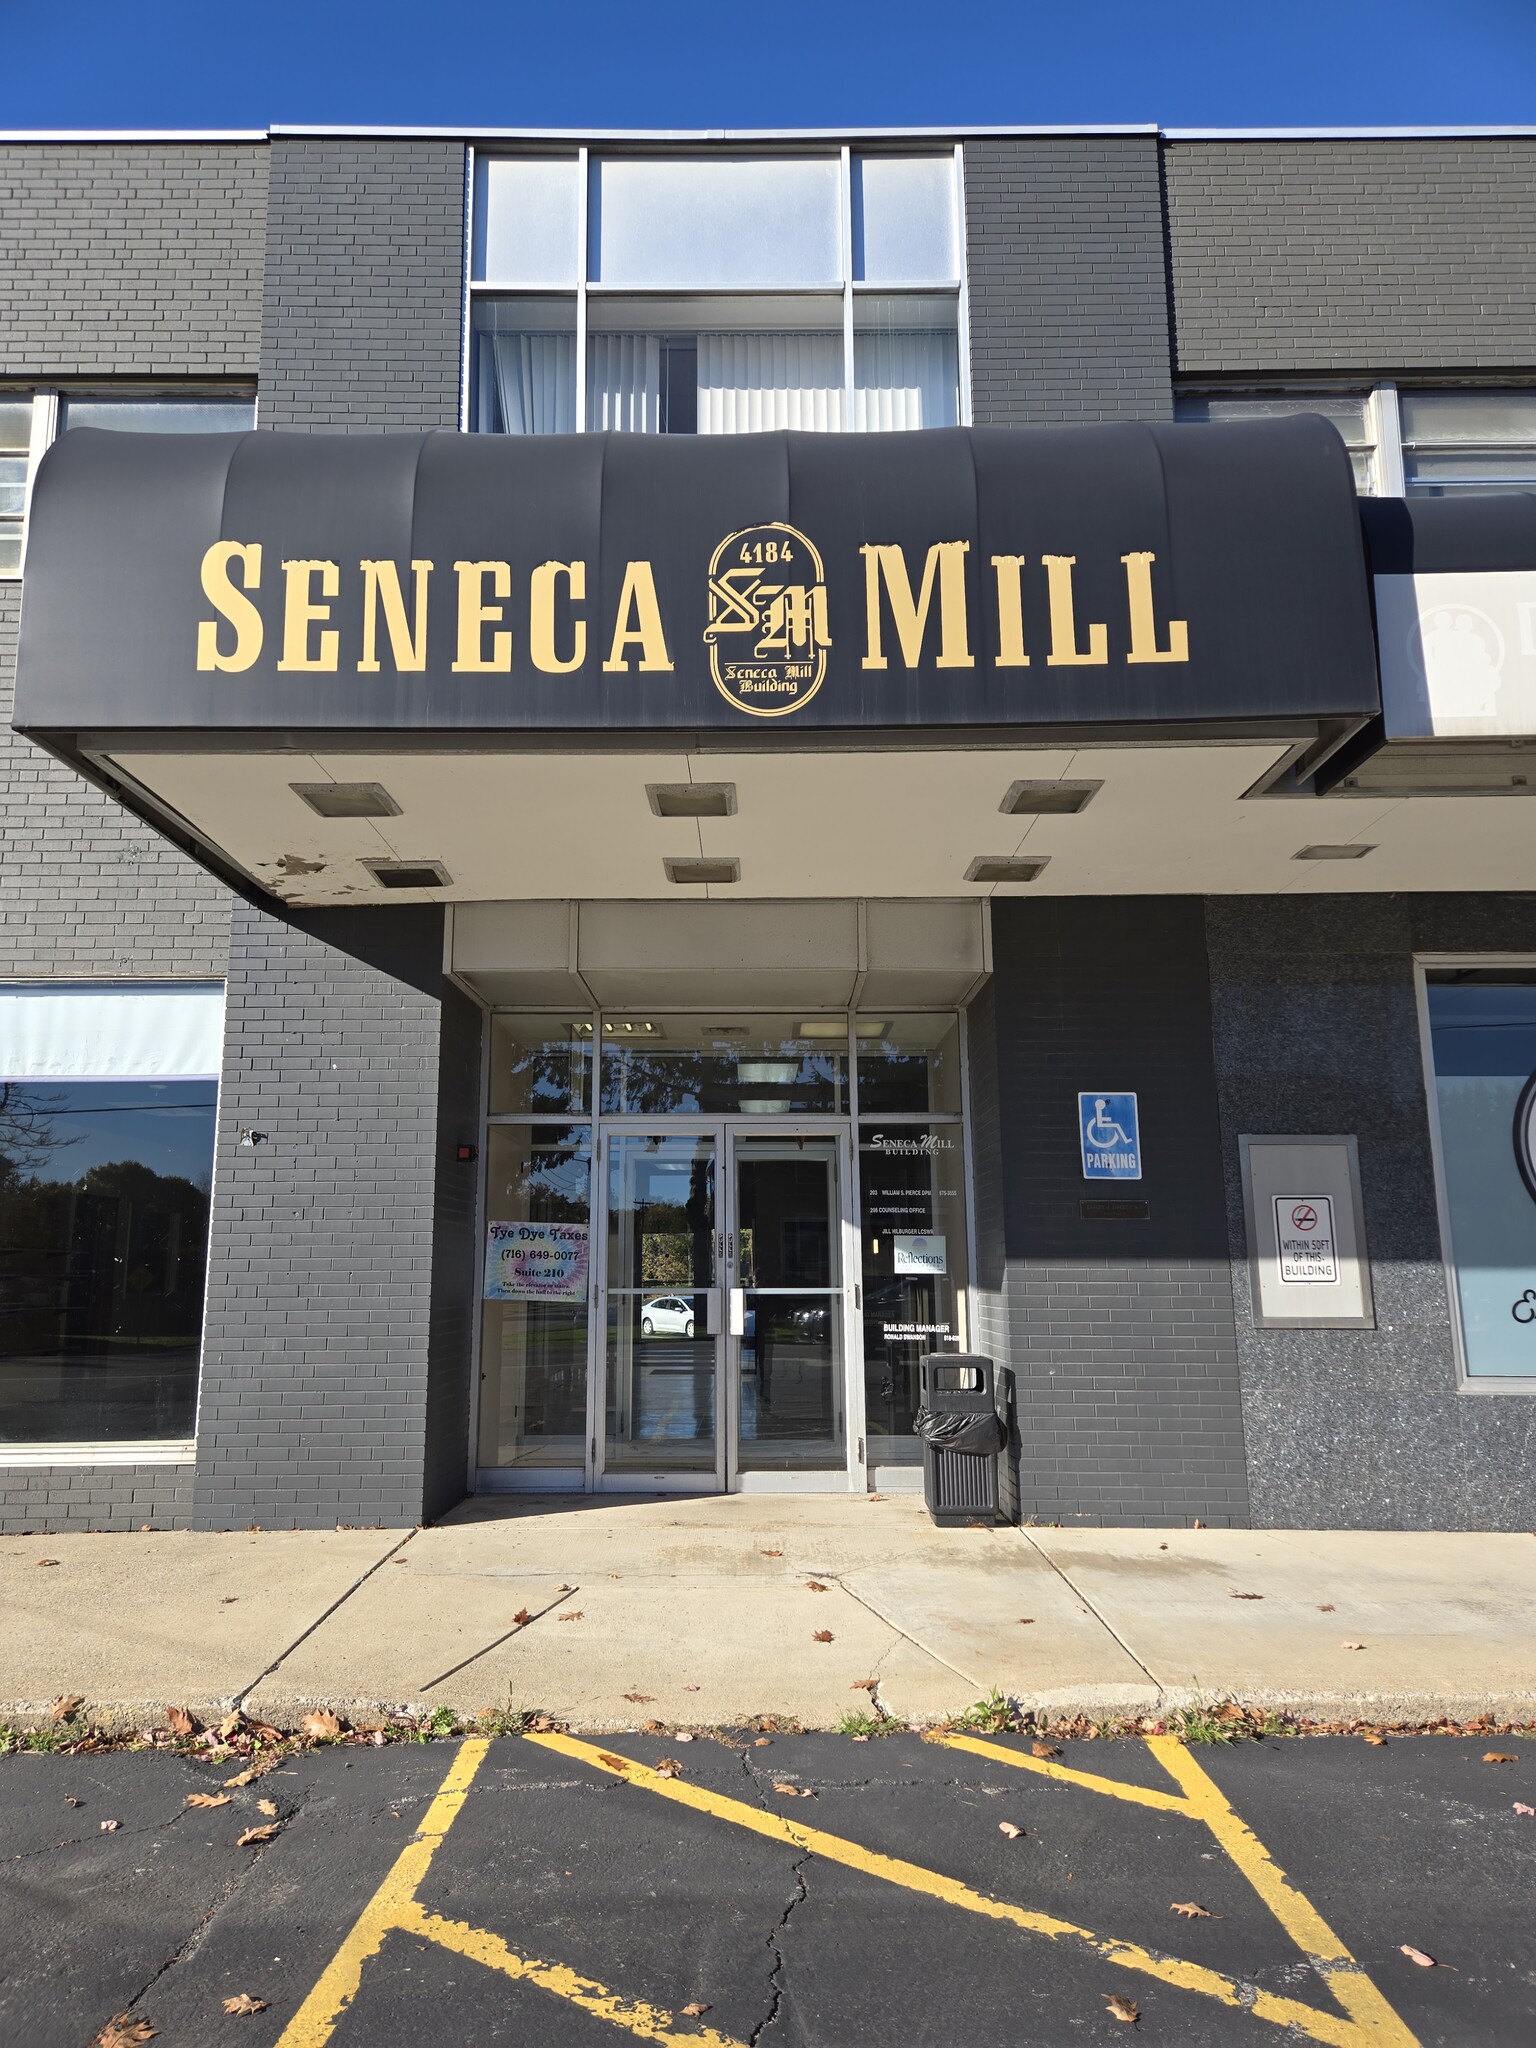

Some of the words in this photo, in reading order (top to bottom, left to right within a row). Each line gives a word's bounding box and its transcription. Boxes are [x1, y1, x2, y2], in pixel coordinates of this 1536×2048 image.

[740, 541, 794, 564] 4184
[197, 540, 674, 673] SENECA
[859, 540, 1189, 670] MILL
[725, 665, 778, 680] Seneca
[785, 664, 813, 679] Mill
[739, 679, 798, 695] Building
[870, 1134, 918, 1149] SENECA
[920, 1134, 954, 1149] MILL
[1087, 1153, 1136, 1169] PARKING
[491, 1226, 514, 1240] Tye
[519, 1227, 545, 1241] Dye
[550, 1228, 588, 1241] Taxes
[1282, 1240, 1310, 1250] WITHIN
[501, 1249, 525, 1261] (716)
[530, 1250, 580, 1261] 649-0077
[898, 1252, 944, 1264] Reflections
[1293, 1252, 1303, 1262] OF
[514, 1268, 542, 1278] Suite
[544, 1269, 565, 1278] 210
[1285, 1265, 1332, 1275] BUILDING
[884, 1324, 915, 1332] BUILDING
[916, 1325, 950, 1333] MANAGER
